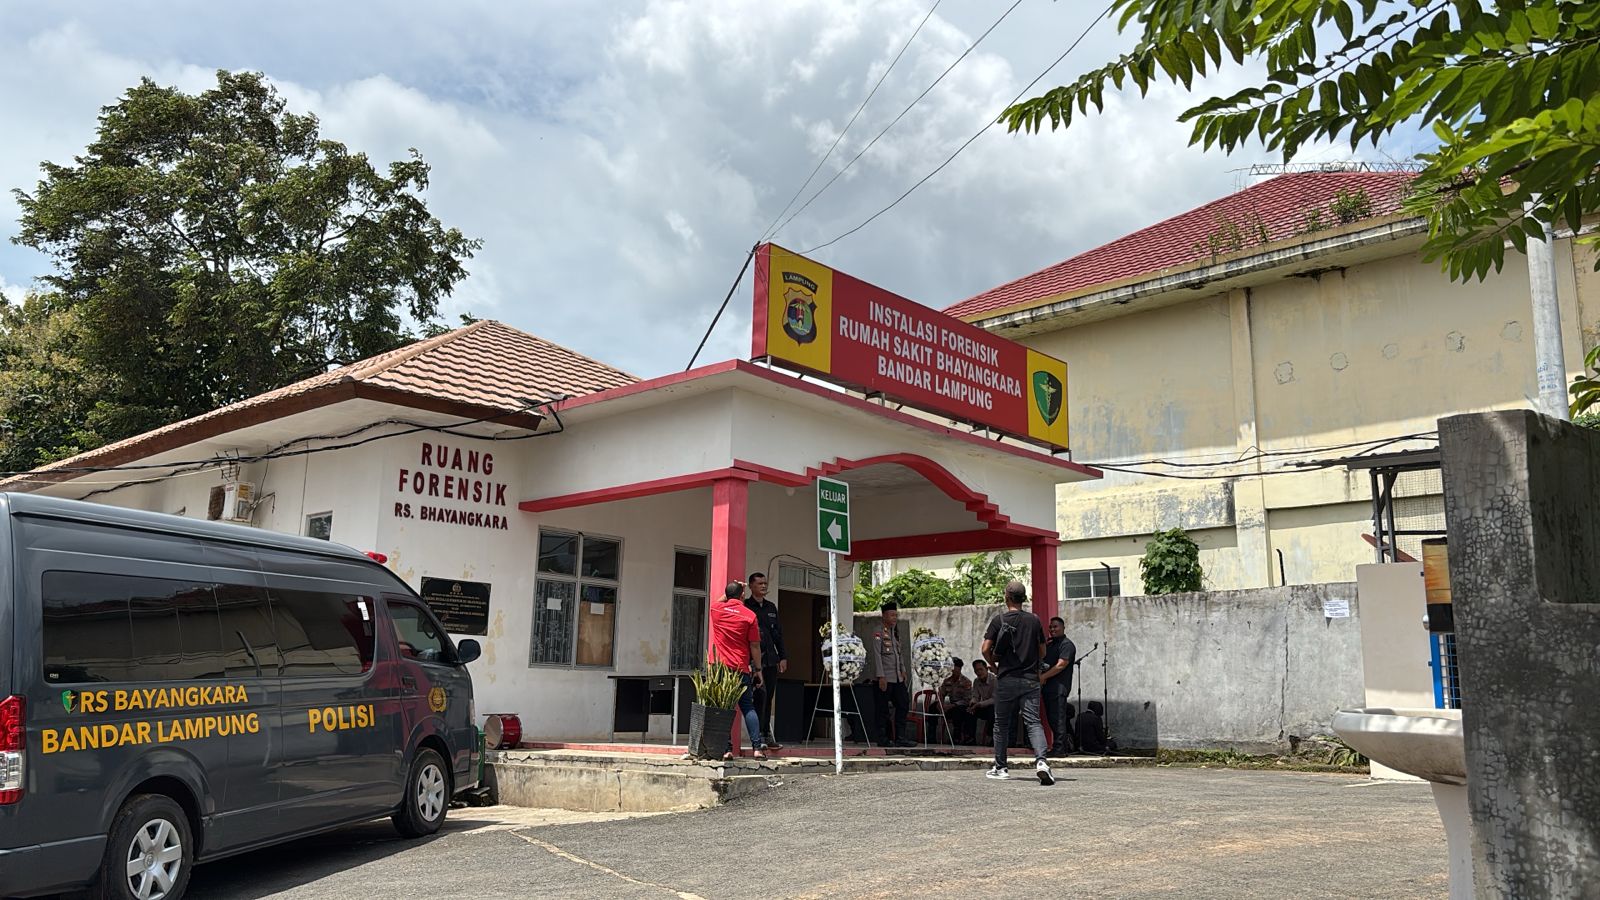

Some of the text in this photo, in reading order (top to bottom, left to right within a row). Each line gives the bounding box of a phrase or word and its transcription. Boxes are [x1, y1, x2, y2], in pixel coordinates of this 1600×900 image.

[784, 275, 815, 290] LAMPUNG
[869, 301, 999, 368] INSTALASI FORENSIK
[839, 316, 1022, 398] RUMAH SAKIT BHAYANGKARA
[878, 355, 993, 410] BANDAR LAMPUNG
[421, 442, 494, 475] RUANG
[398, 469, 507, 506] FORENSIK
[820, 488, 846, 504] KELUAR
[395, 502, 508, 530] RS. BHAYANGKARA
[80, 685, 249, 713] RS BAYANGKARA
[42, 713, 260, 754] BANDAR LAMPUNG
[308, 704, 375, 733] POLISI
